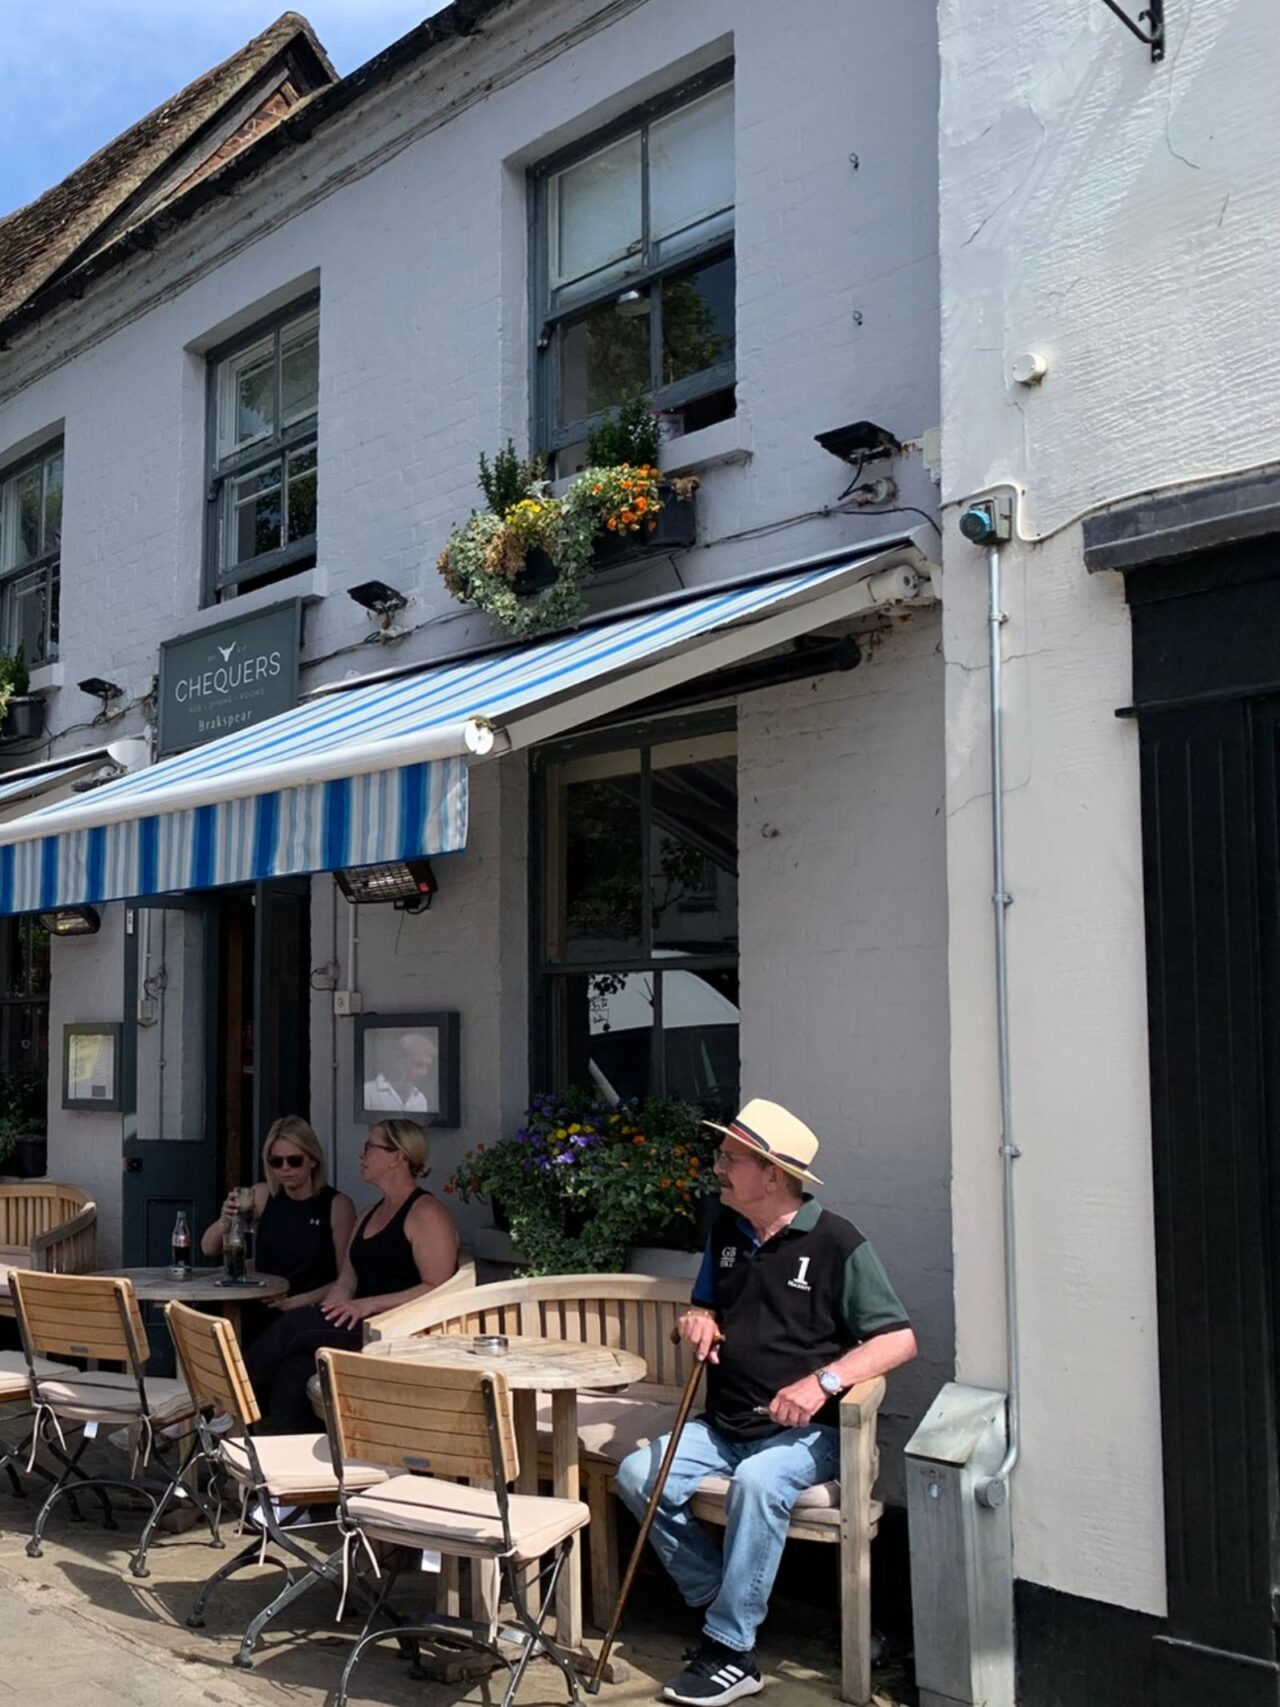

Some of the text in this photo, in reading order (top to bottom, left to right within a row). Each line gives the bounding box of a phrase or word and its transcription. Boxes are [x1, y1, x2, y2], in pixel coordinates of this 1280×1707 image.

[175, 651, 281, 702] CHEQUERS
[198, 710, 252, 733] Brakspear
[793, 1256, 811, 1286] 1
